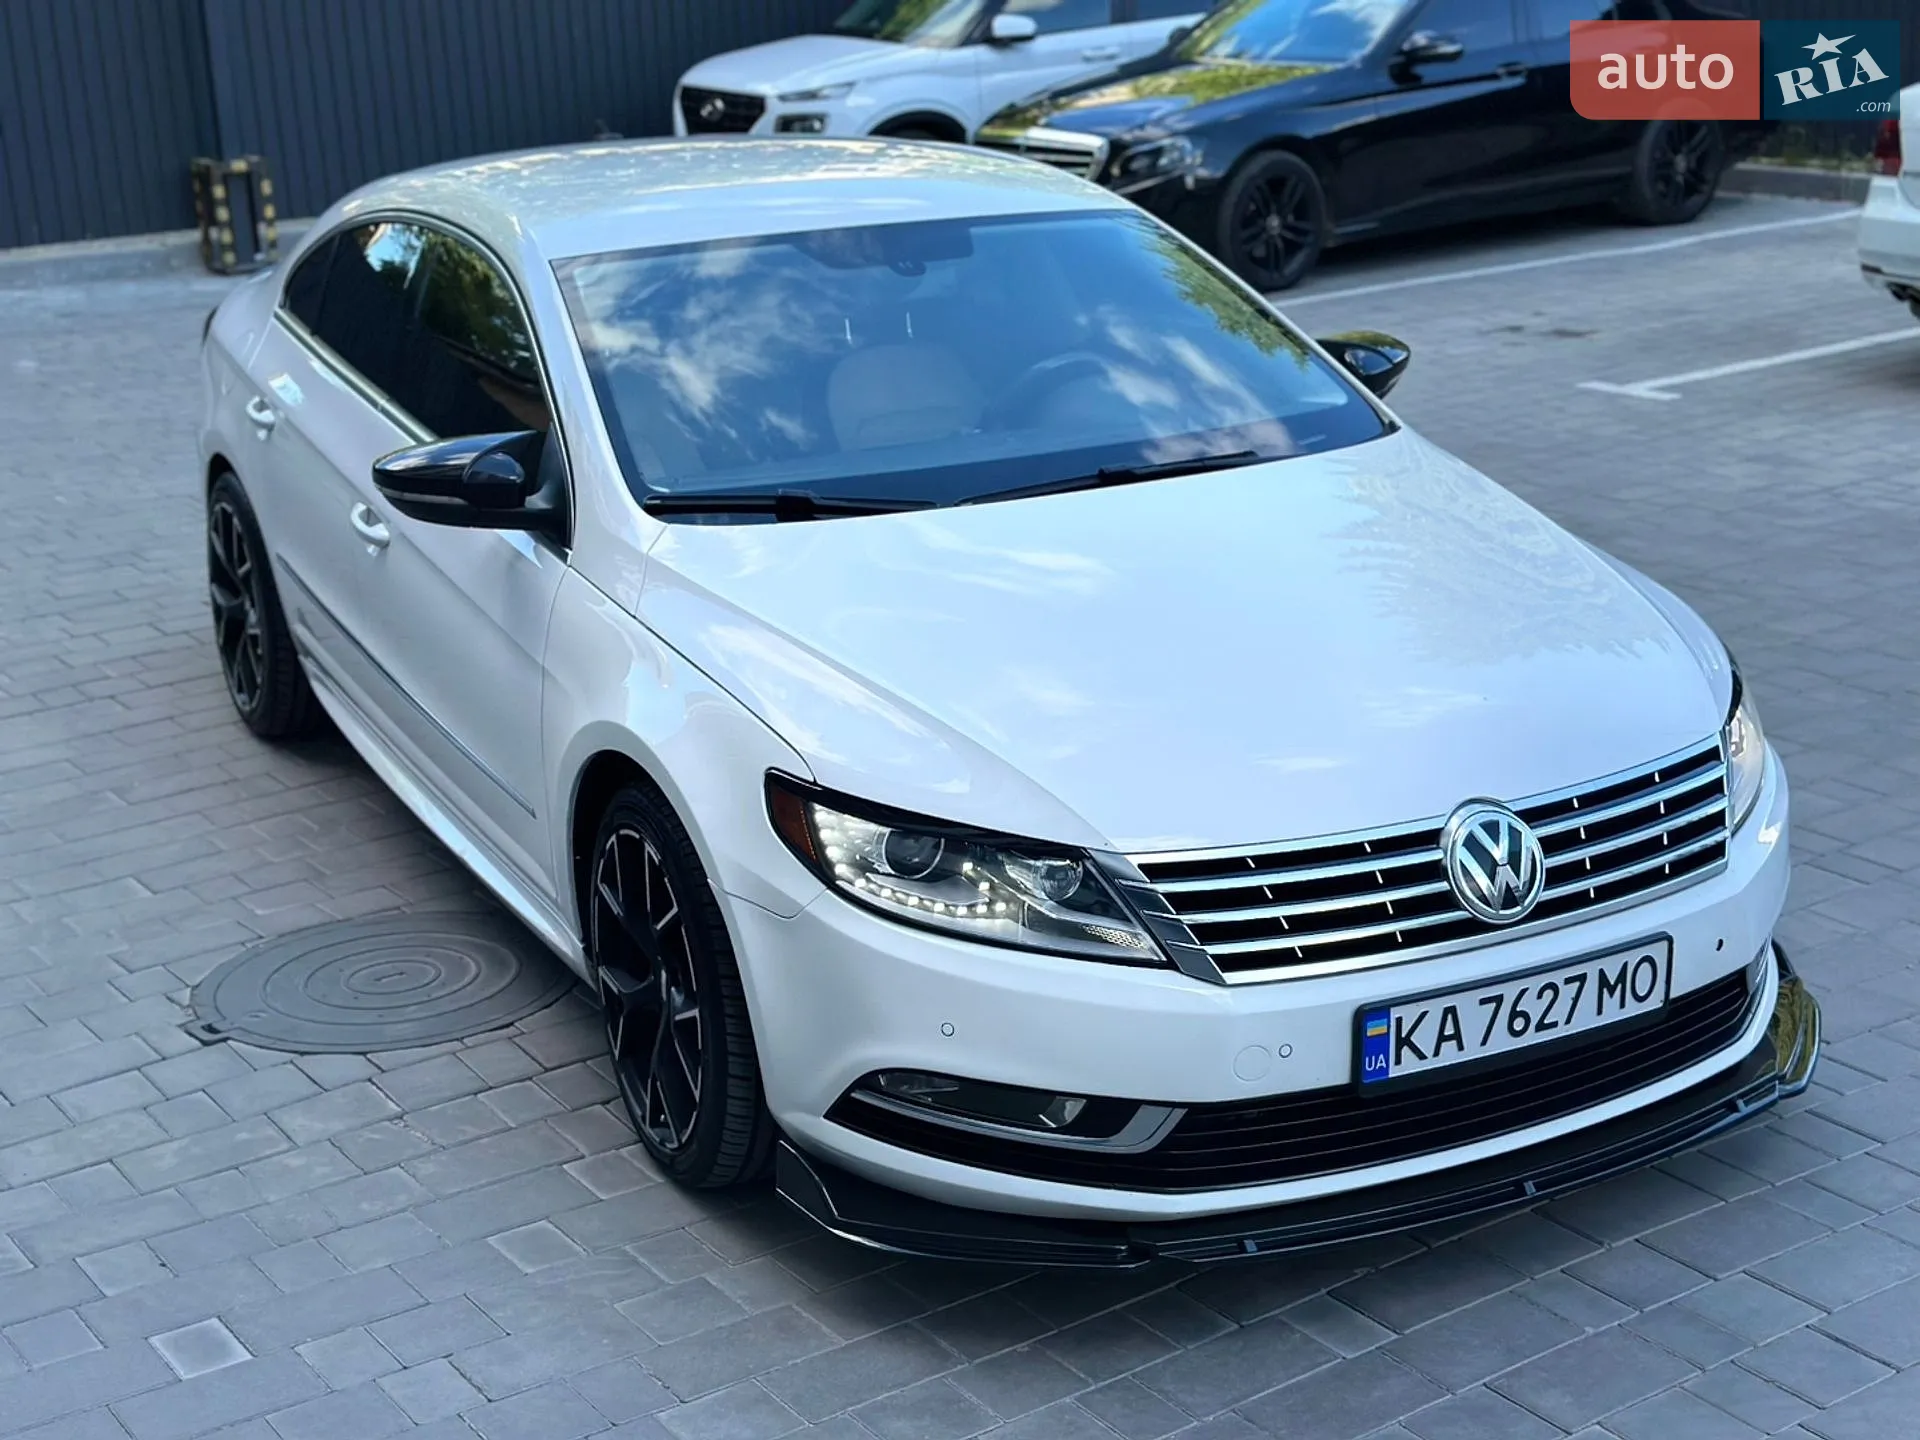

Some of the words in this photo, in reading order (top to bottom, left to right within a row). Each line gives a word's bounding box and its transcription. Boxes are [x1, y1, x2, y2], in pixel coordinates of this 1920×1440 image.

[1393, 1004, 1466, 1067] KA
[1478, 972, 1588, 1047] 7627
[1596, 954, 1658, 1017] MO
[1364, 1055, 1387, 1072] UA
